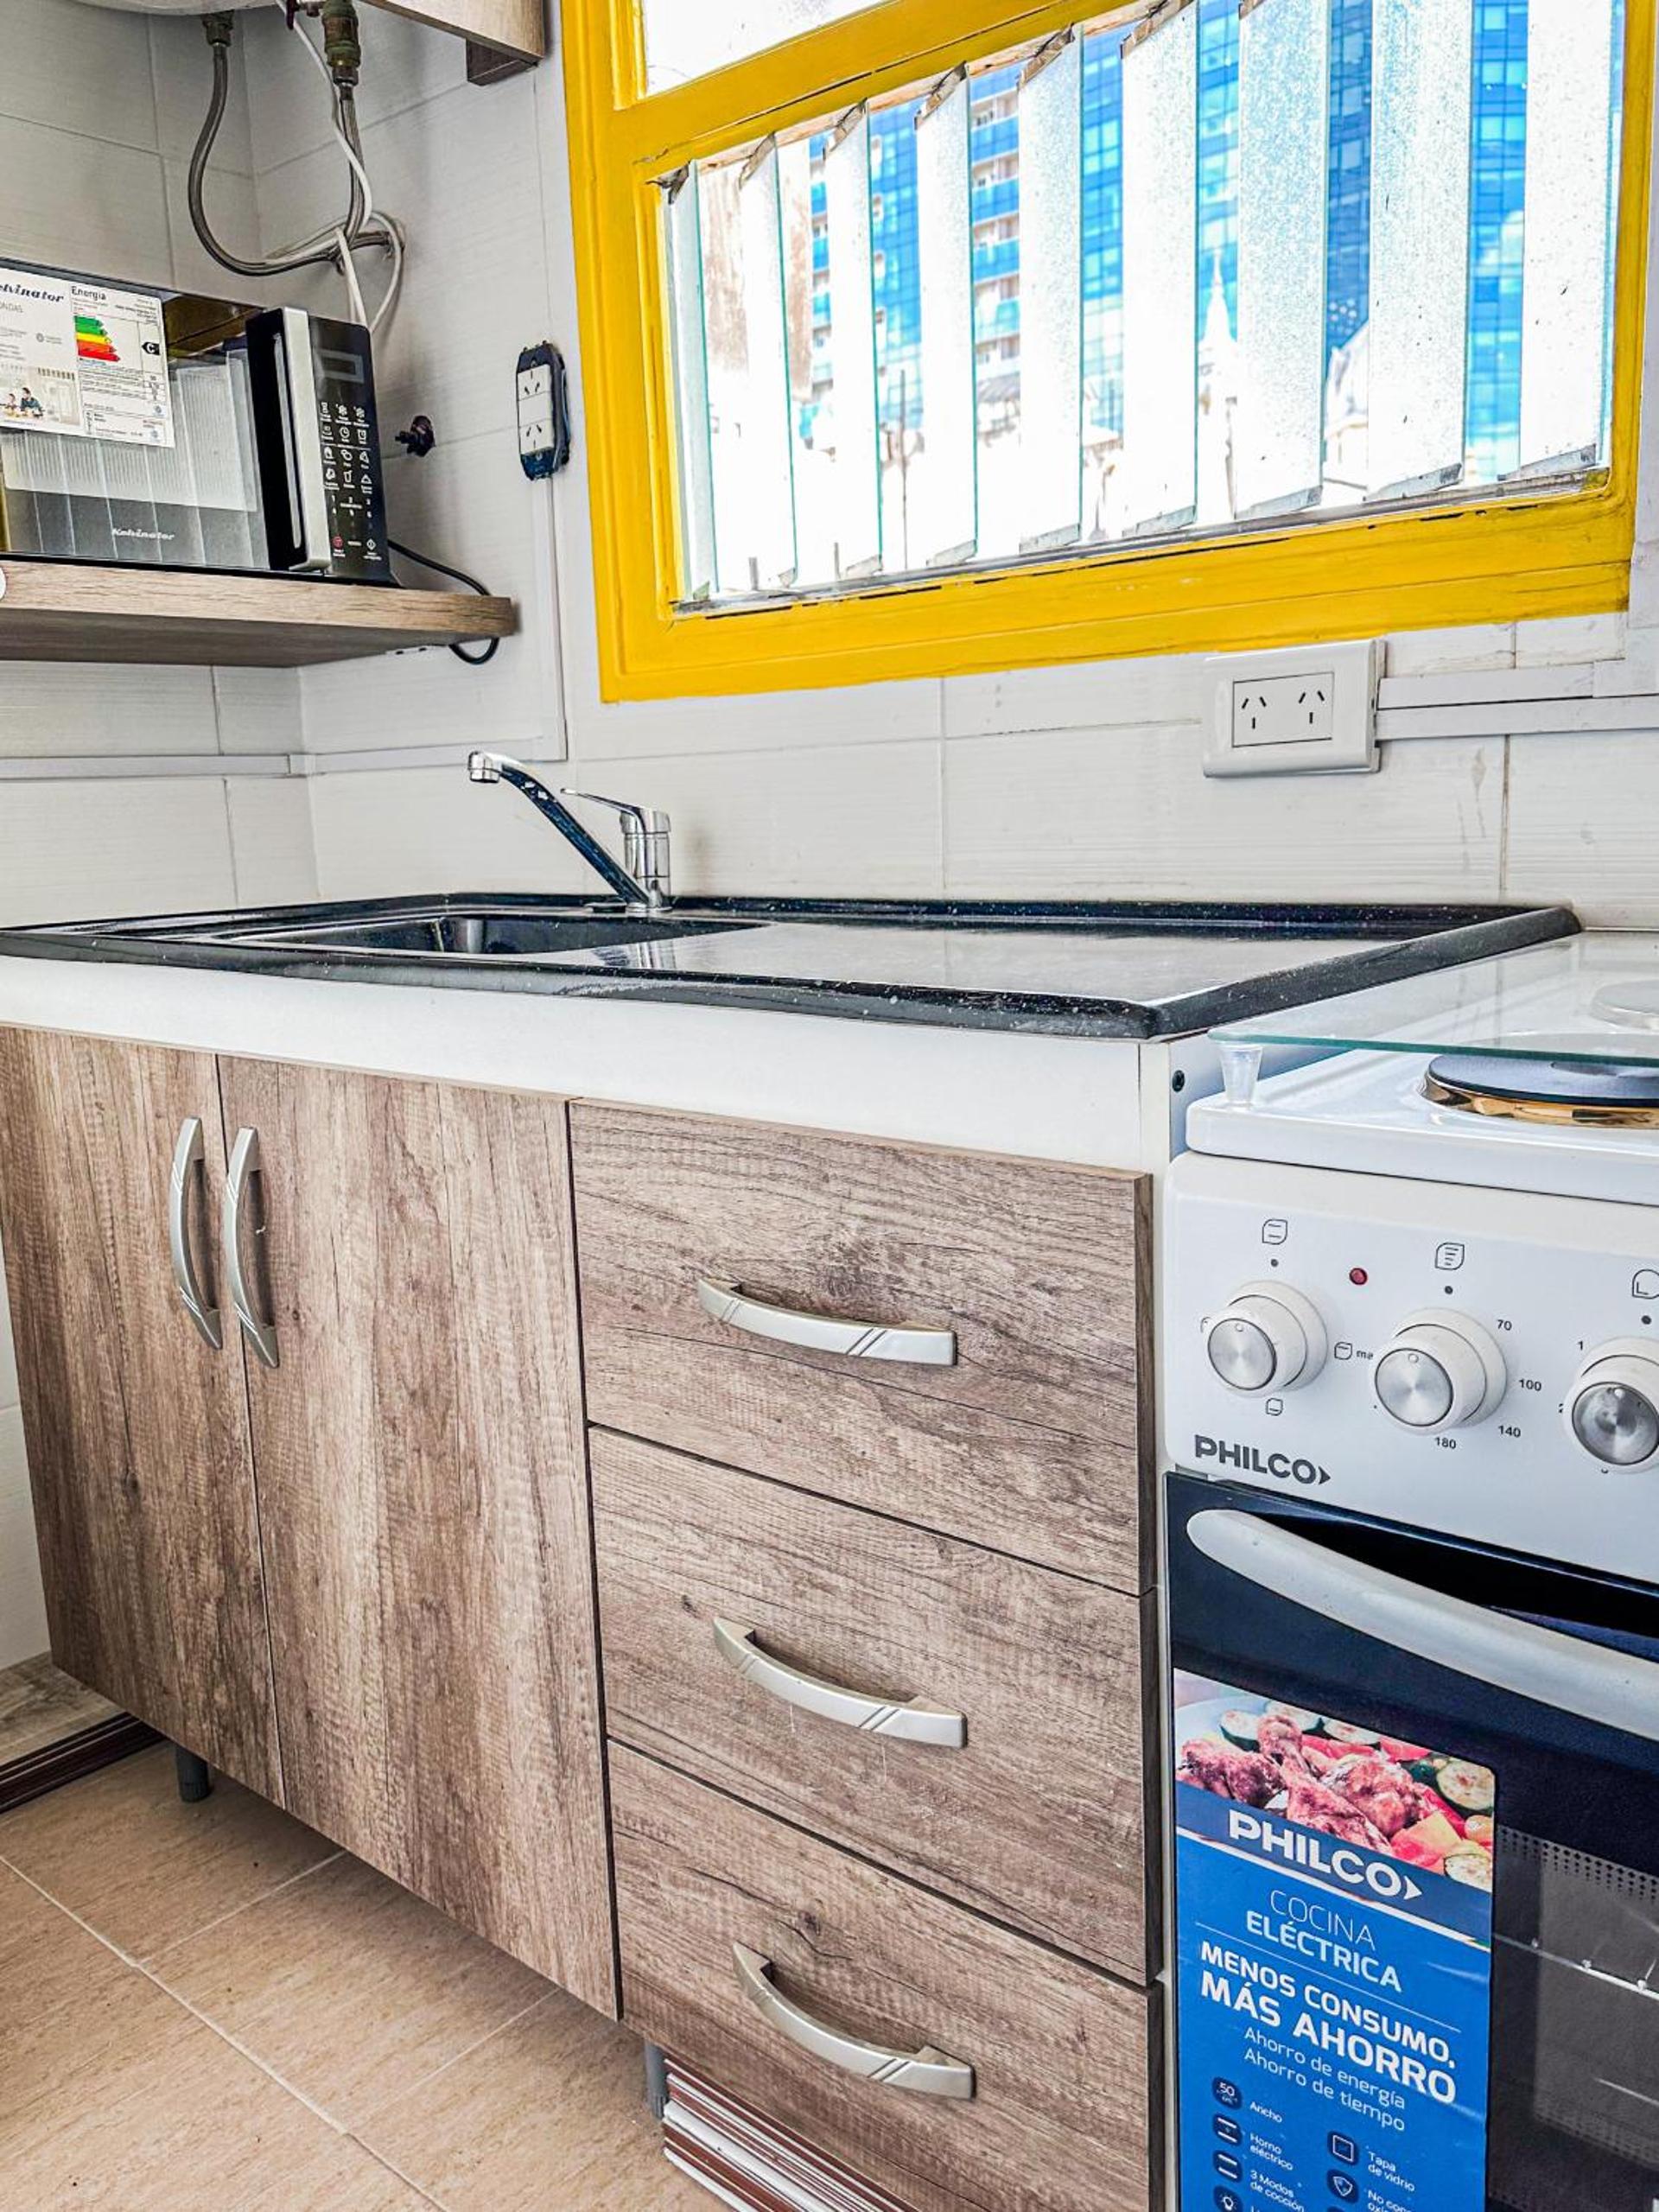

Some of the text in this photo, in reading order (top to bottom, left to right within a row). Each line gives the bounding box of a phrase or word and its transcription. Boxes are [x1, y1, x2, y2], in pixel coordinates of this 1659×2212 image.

[1497, 1319, 1512, 1332] 70
[1578, 1340, 1584, 1351] 1
[1518, 1378, 1541, 1392] 100
[1434, 1436, 1457, 1449] 180
[1498, 1425, 1521, 1438] 140
[1194, 1433, 1317, 1485] PHILCO
[1229, 1808, 1402, 1897] PHILCO
[1270, 1890, 1376, 1951] COCINA
[1246, 1910, 1402, 1993] ELÉCTRICA
[1201, 1941, 1456, 2069] MENOS CONSUMO.
[1201, 1970, 1457, 2104] MÁS AHORRO
[1244, 2027, 1406, 2110] Ahorro de energía
[1219, 2082, 1236, 2097] 50
[1244, 2048, 1406, 2132] Ahorro de tiempo
[1249, 2101, 1283, 2123] Ancho
[1249, 2133, 1282, 2155] Horno
[1368, 2151, 1396, 2172] Tapa
[1368, 2164, 1382, 2177] de
[1249, 2170, 1294, 2198] 3 Modos
[1249, 2181, 1263, 2193] de
[1368, 2189, 1384, 2204] No
